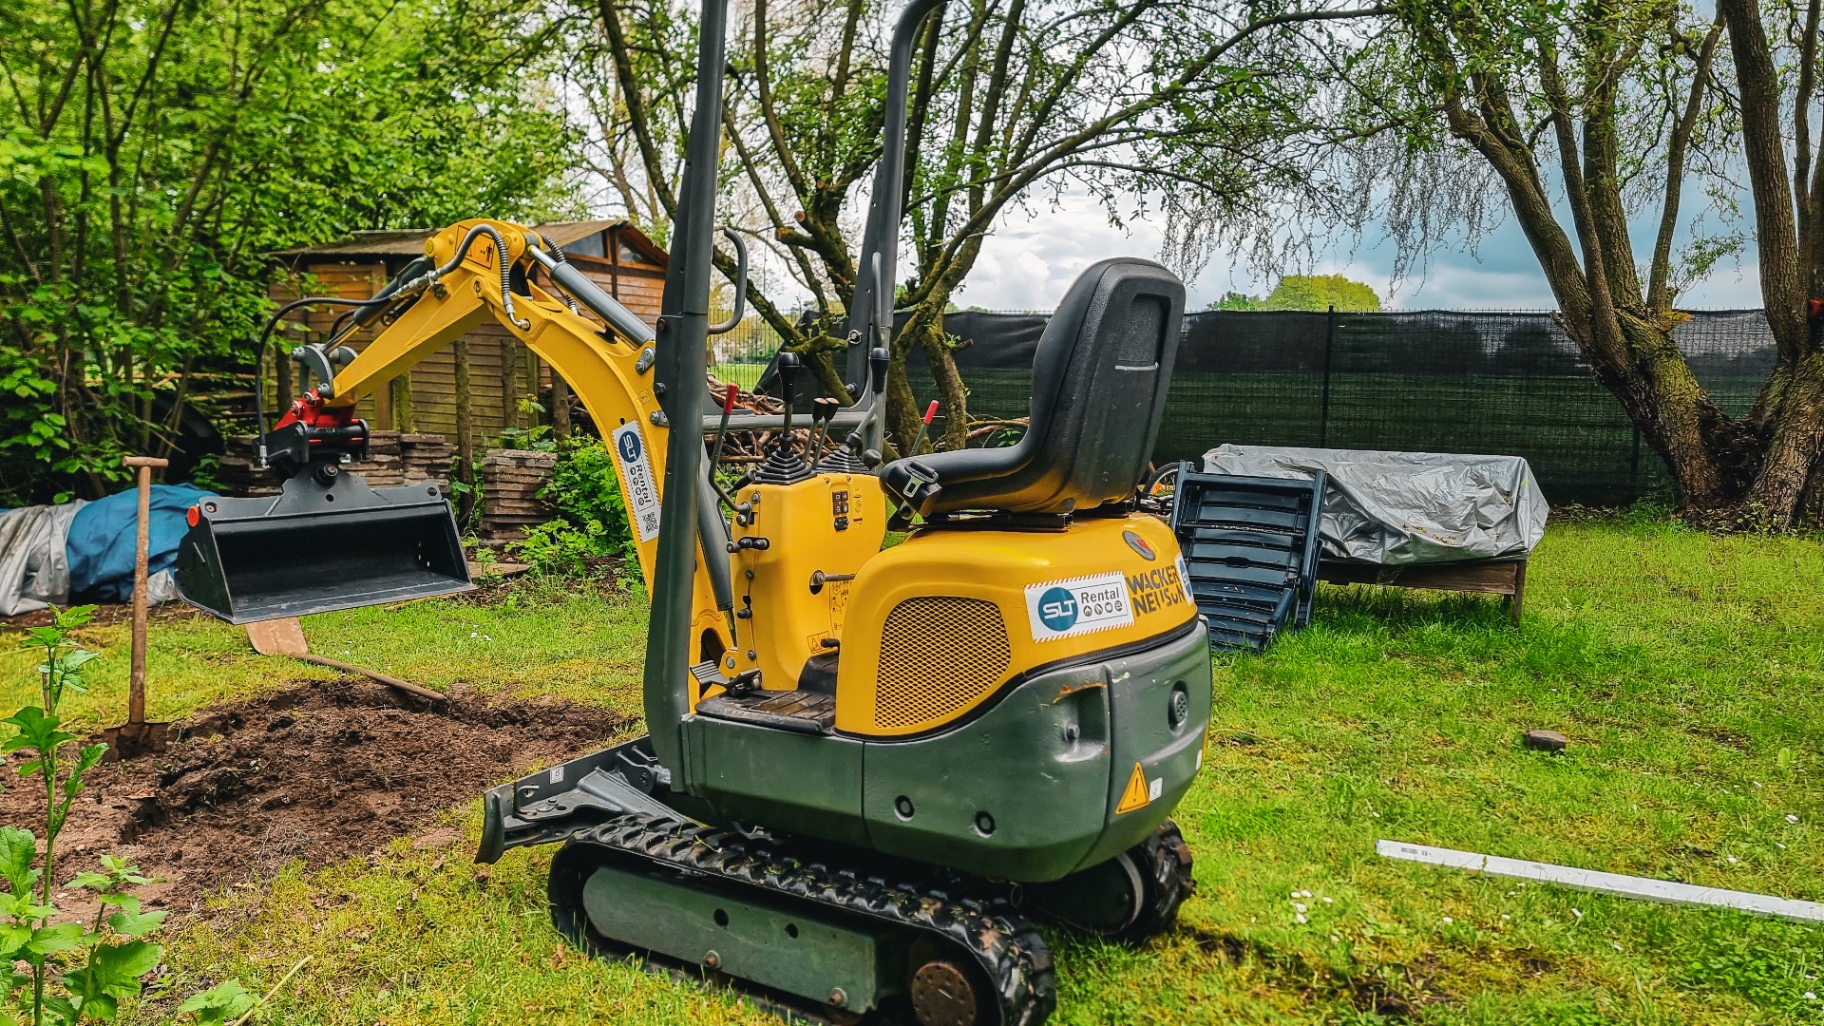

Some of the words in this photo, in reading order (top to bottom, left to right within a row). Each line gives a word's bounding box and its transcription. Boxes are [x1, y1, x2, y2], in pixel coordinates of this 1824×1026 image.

[623, 434, 637, 460] SLT
[636, 464, 652, 503] Rental
[1124, 564, 1181, 595] WACKER
[1042, 599, 1076, 620] SLT
[1080, 587, 1120, 604] Rental
